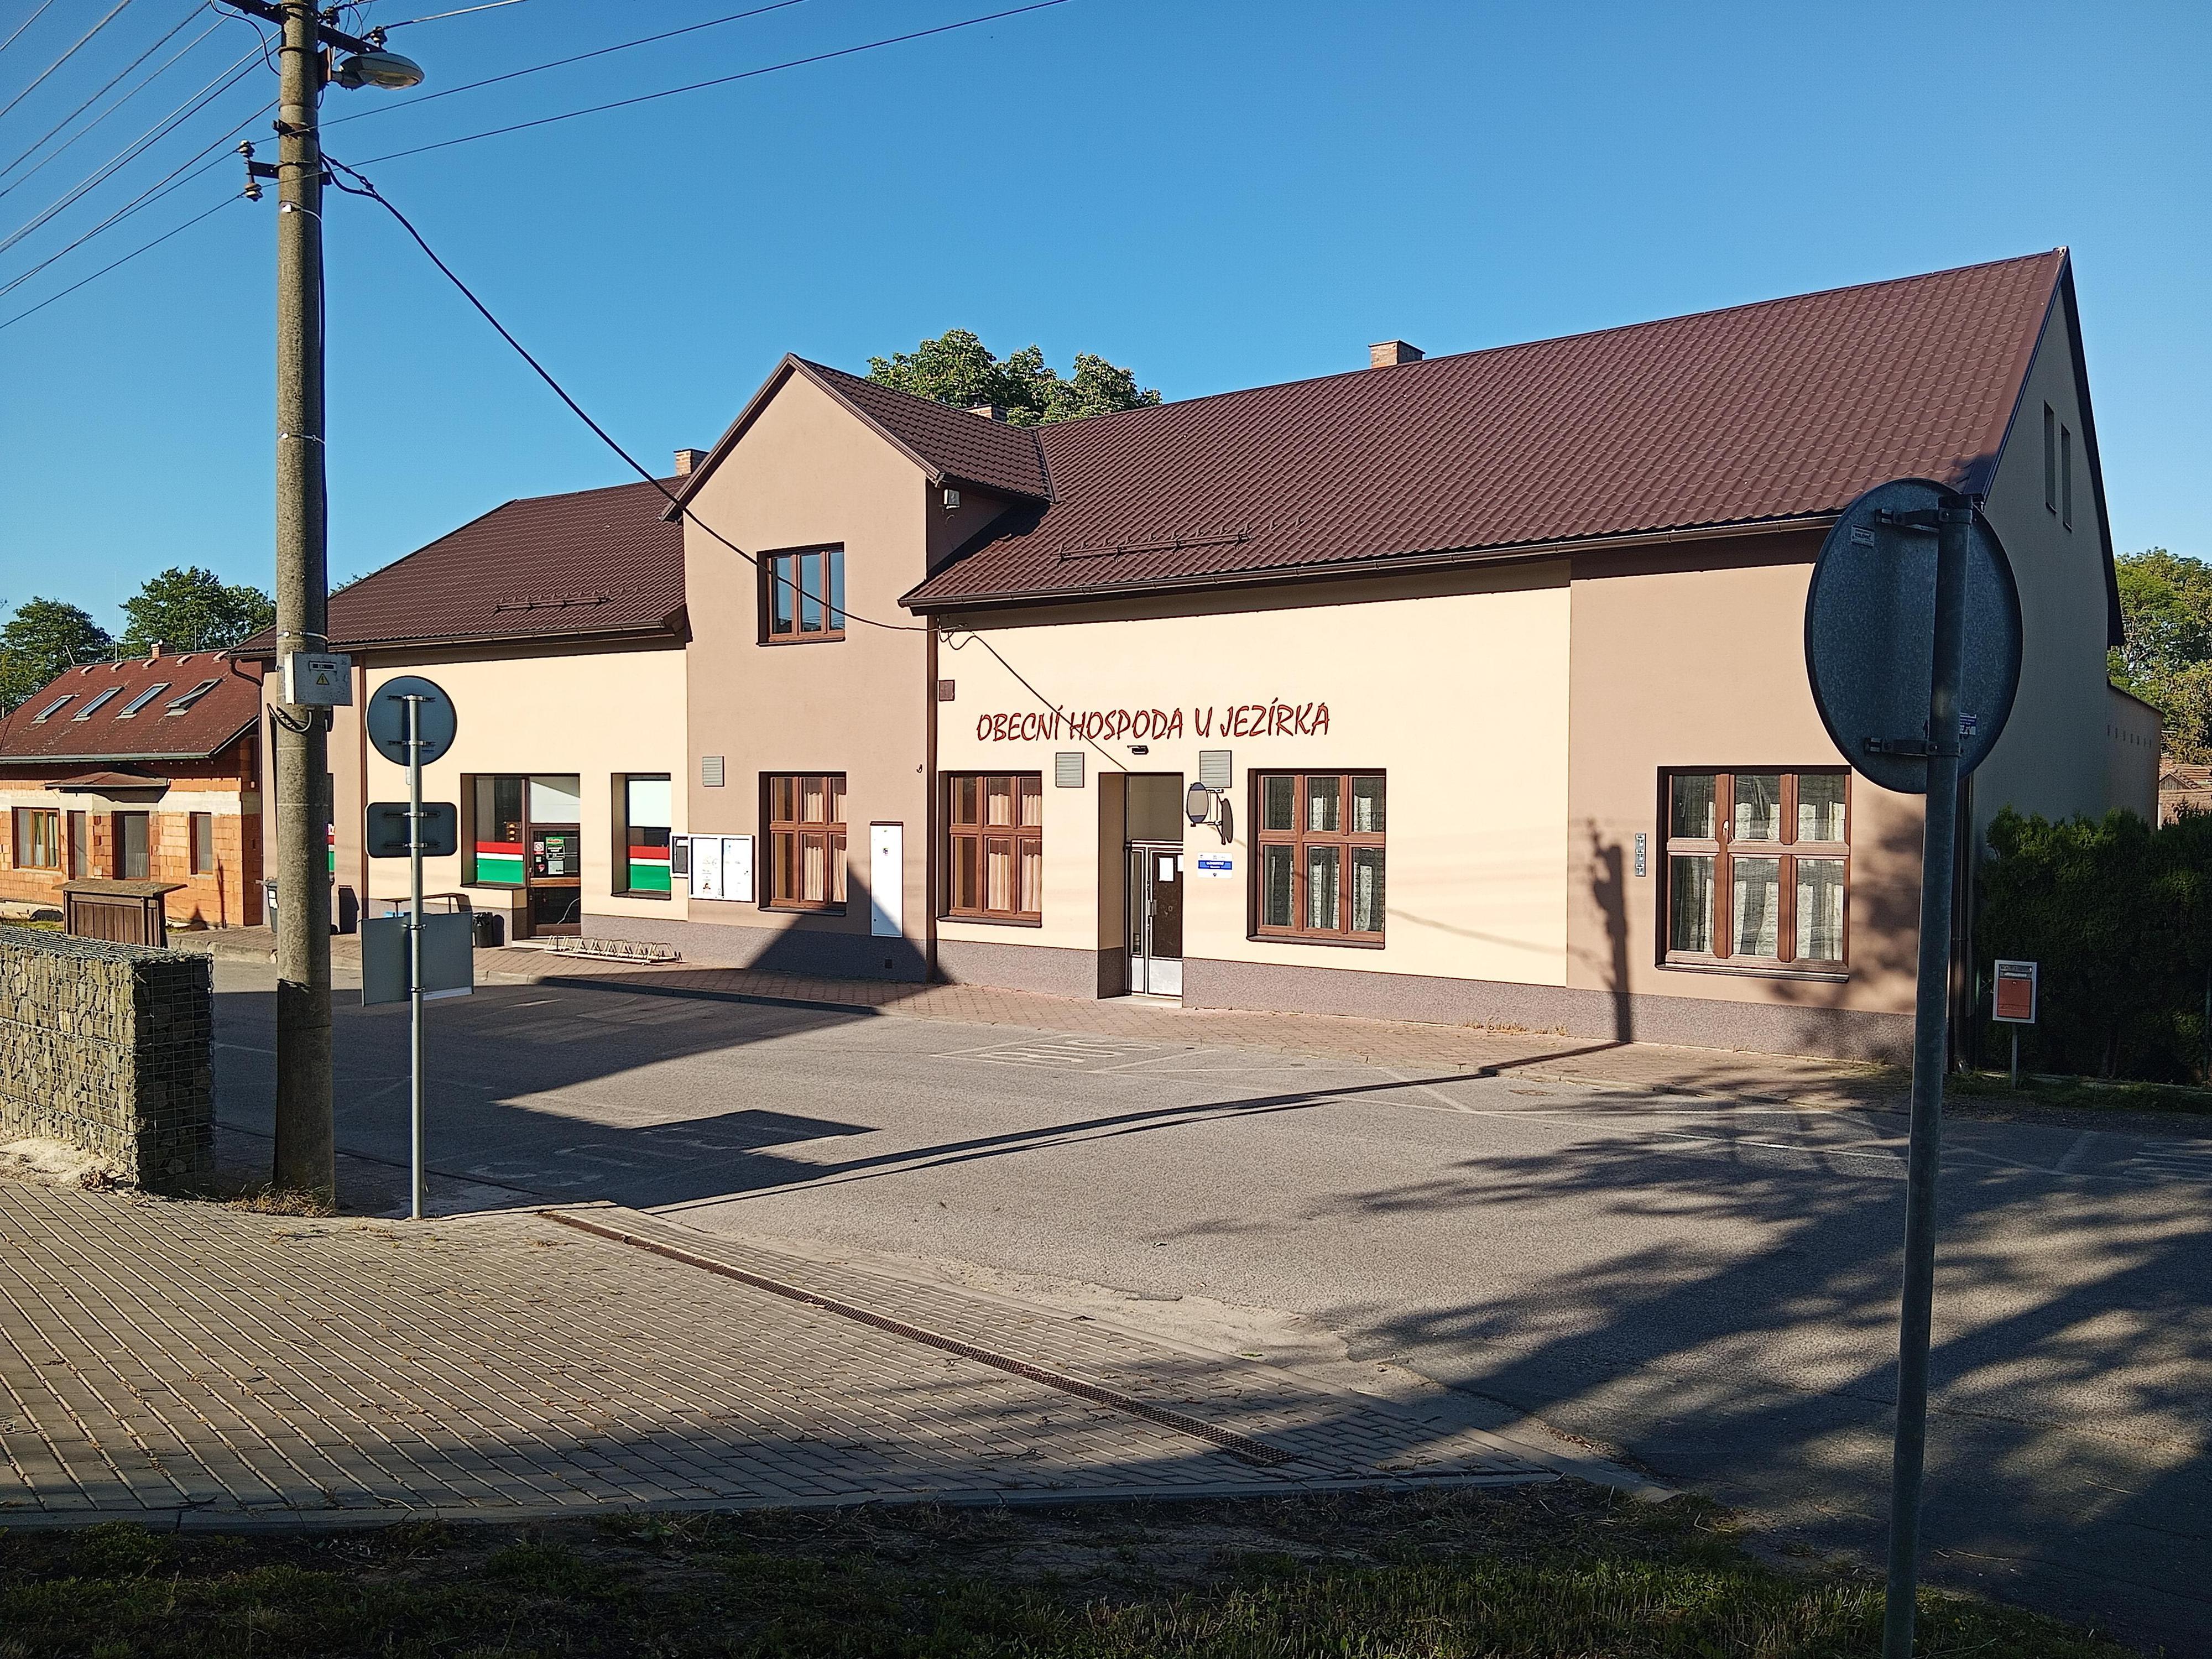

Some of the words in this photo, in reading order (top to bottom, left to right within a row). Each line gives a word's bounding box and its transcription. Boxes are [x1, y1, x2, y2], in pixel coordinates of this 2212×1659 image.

[976, 705, 1063, 742] OBECNÍ
[1069, 708, 1183, 740] HOSPODA
[1195, 707, 1213, 738] U
[1220, 697, 1331, 738] JEZÍRKA
